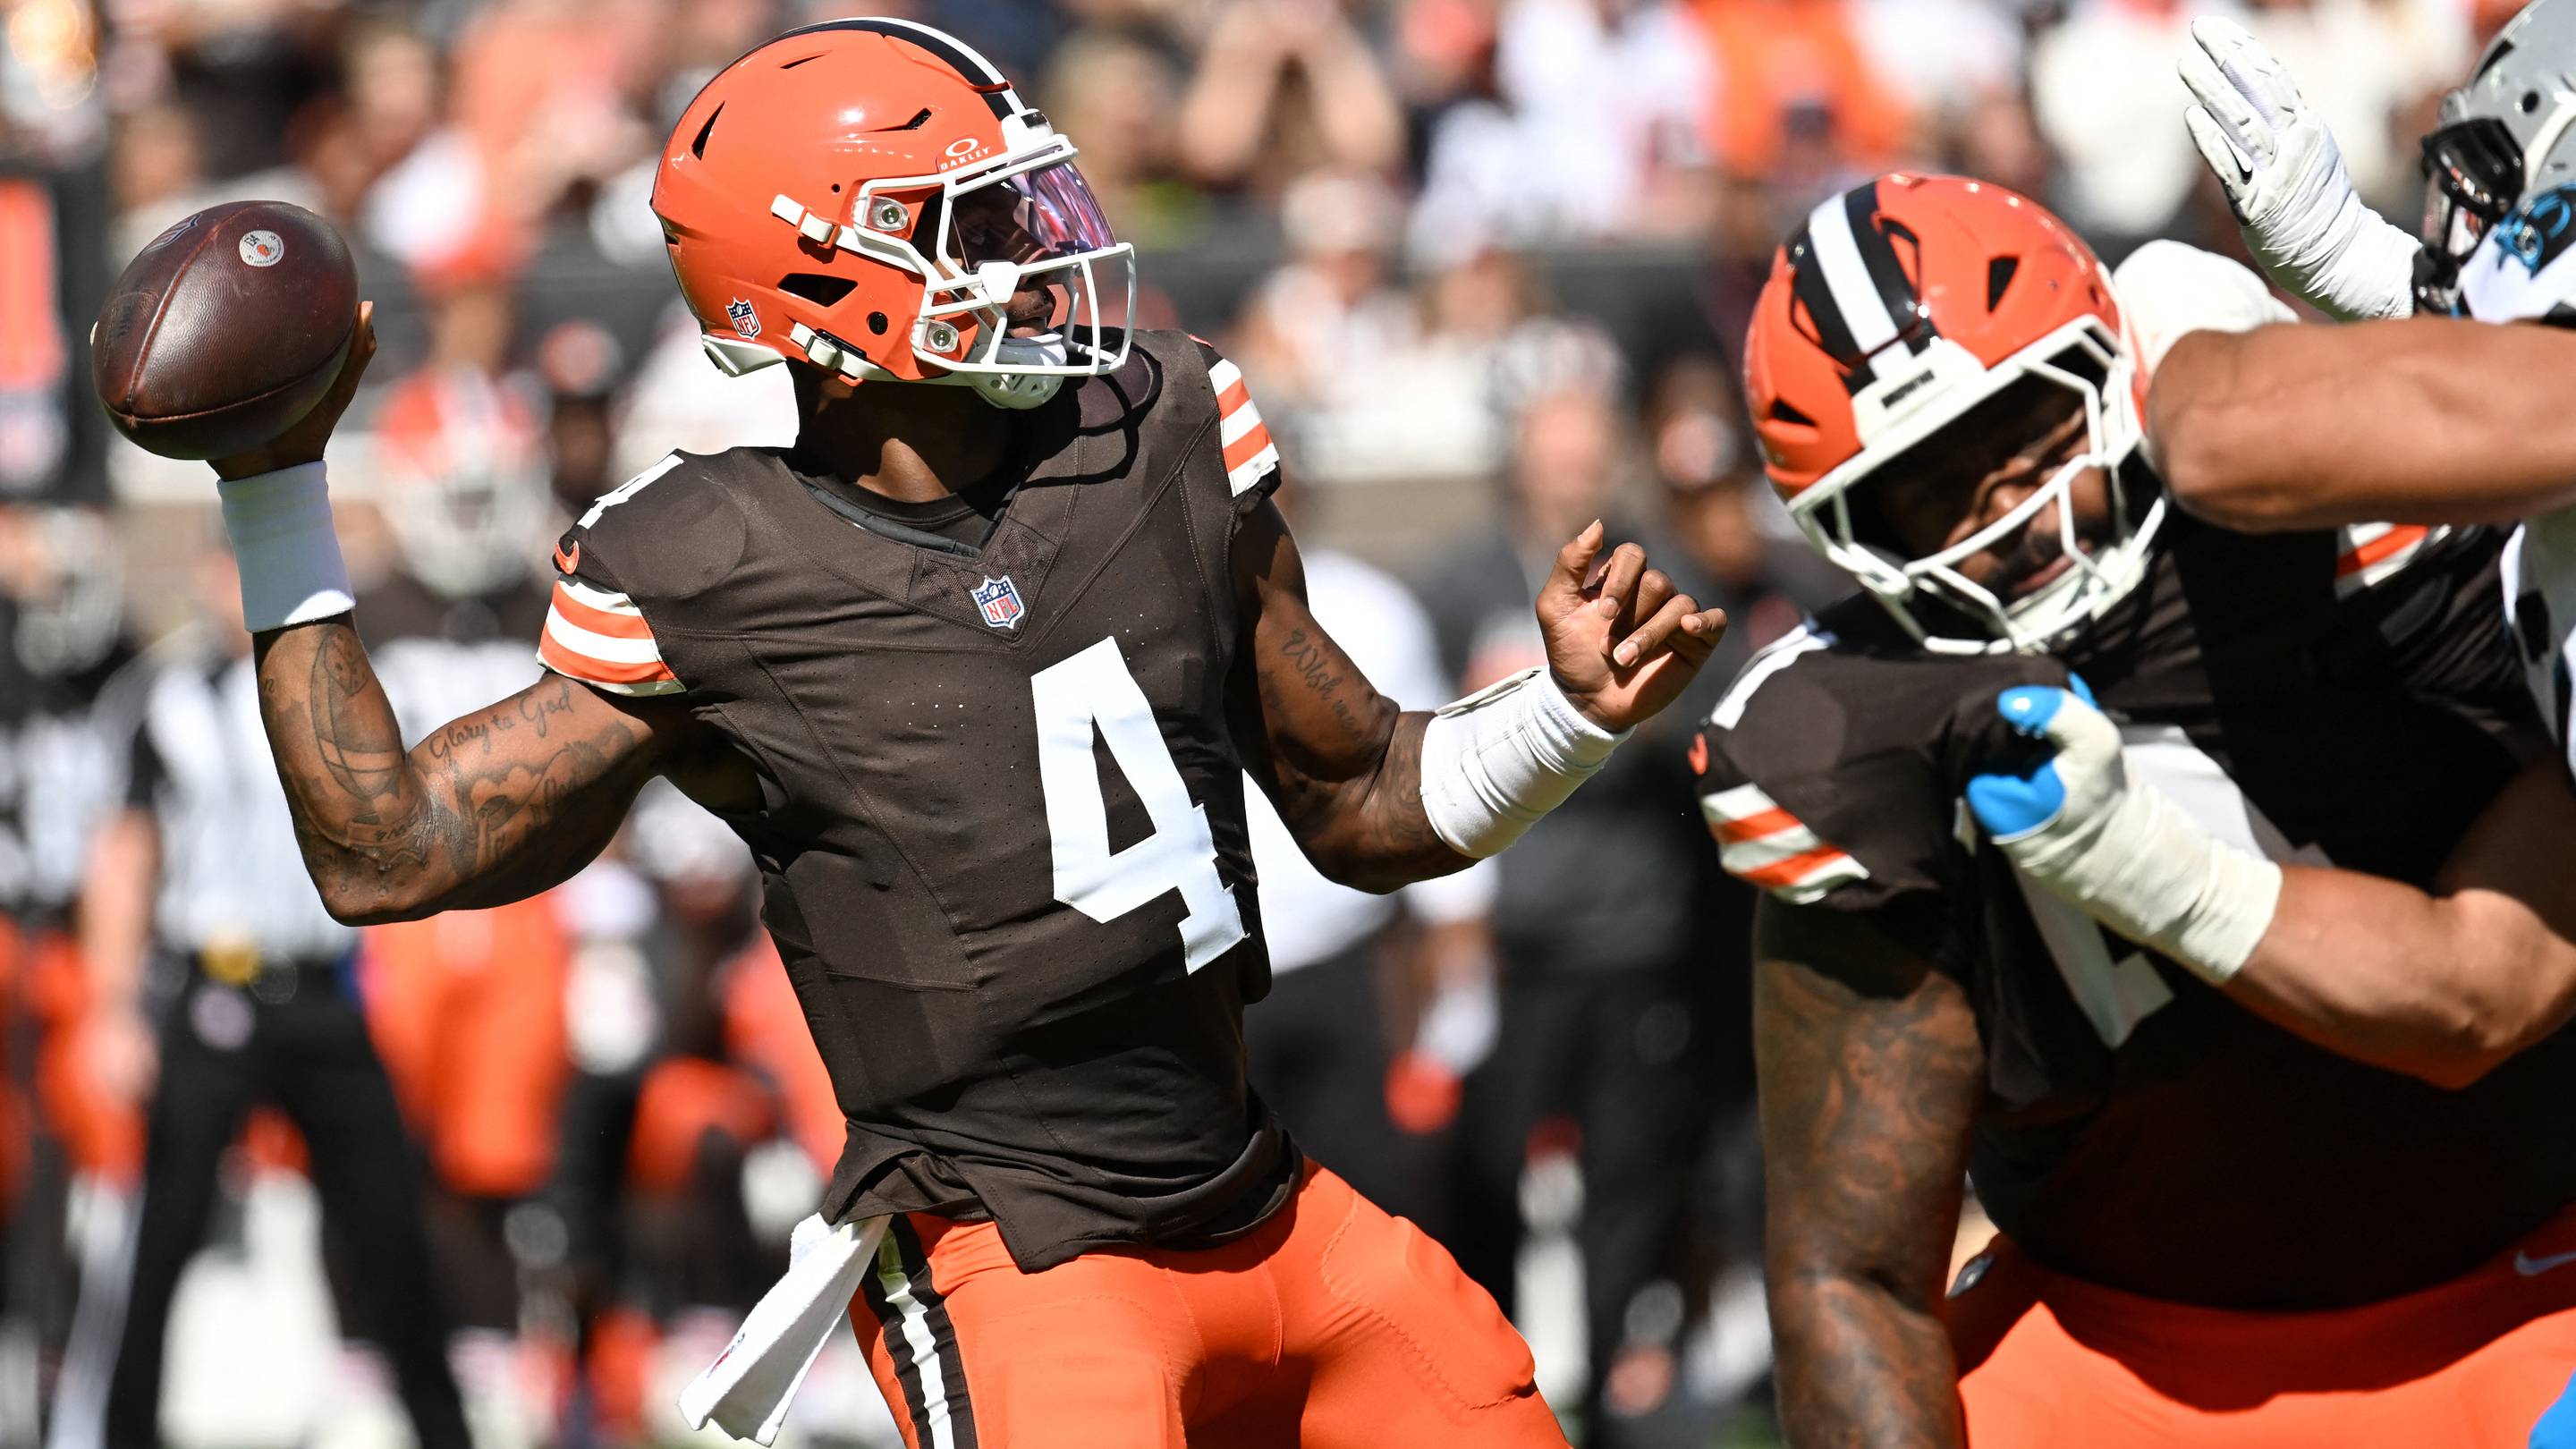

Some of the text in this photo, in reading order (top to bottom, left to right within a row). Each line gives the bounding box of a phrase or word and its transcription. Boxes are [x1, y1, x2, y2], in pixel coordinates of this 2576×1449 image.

[940, 147, 989, 170] OAKLEY
[734, 315, 758, 334] NFL
[986, 596, 1018, 621] NFL
[428, 682, 575, 770] Glory to God
[1030, 636, 1249, 976] 4
